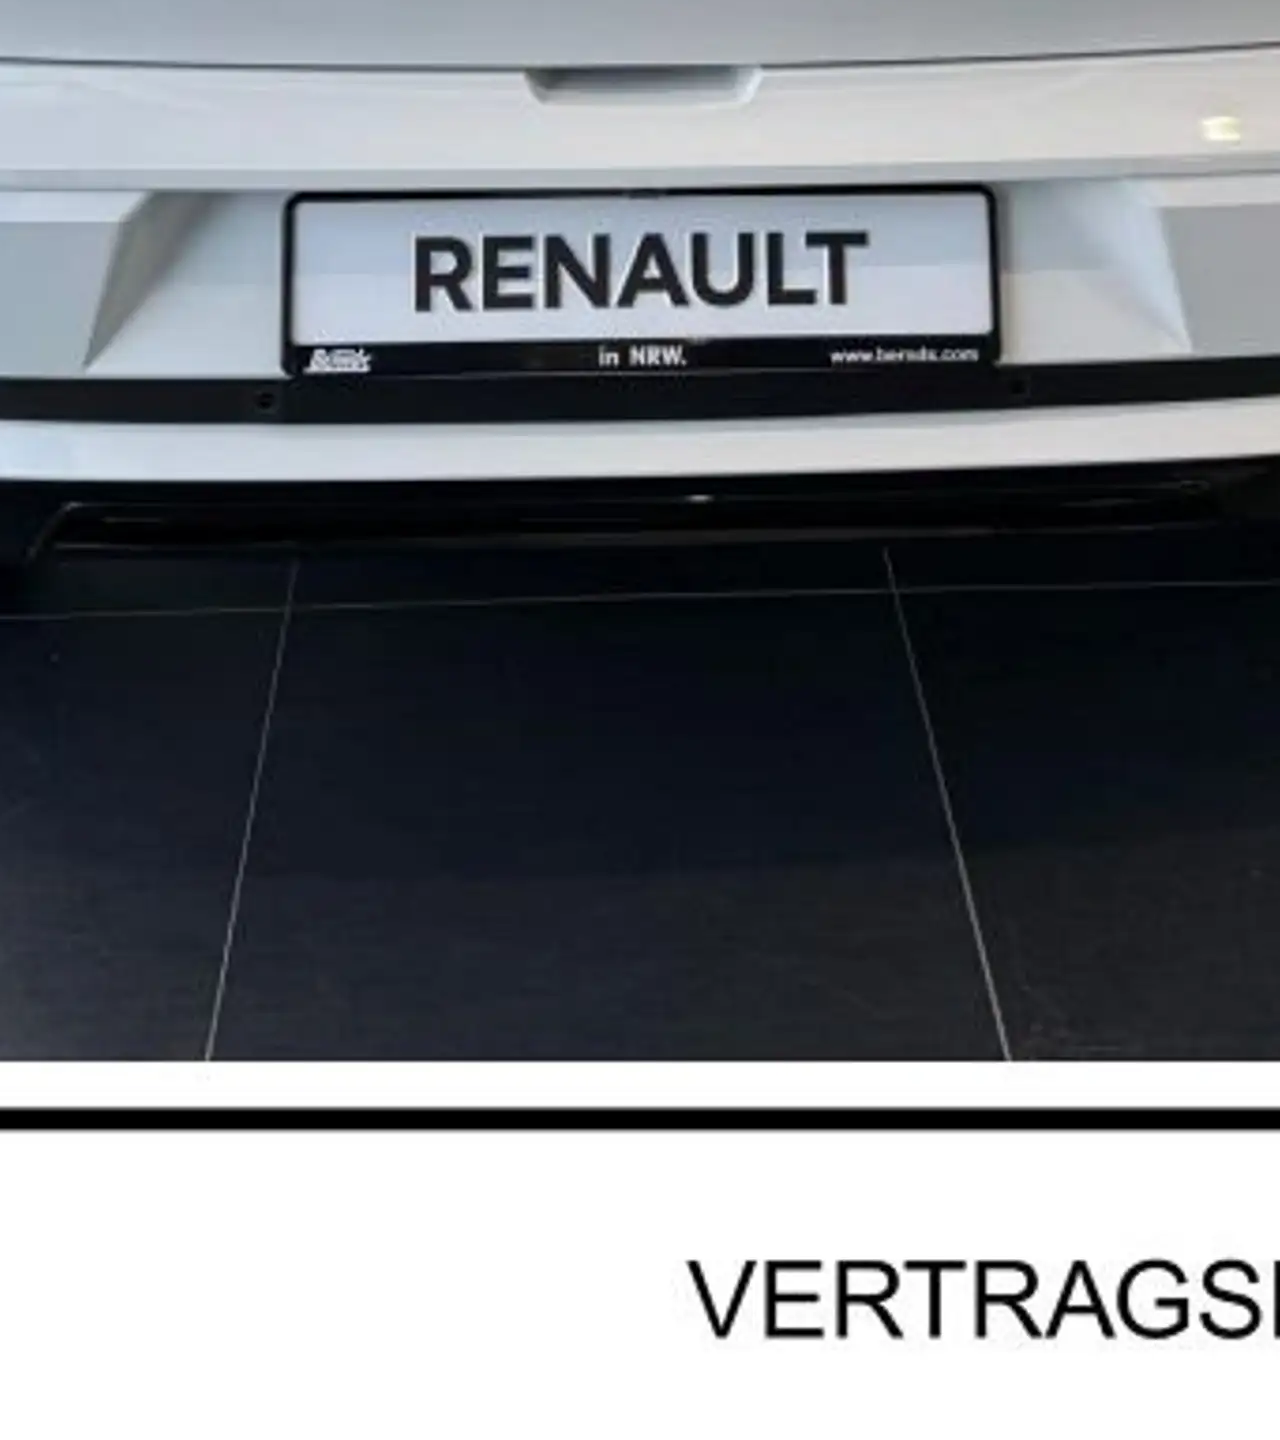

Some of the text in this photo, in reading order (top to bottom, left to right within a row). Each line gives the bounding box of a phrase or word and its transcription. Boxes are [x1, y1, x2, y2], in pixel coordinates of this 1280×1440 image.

[414, 230, 871, 313] RENAULT
[598, 344, 688, 367] in NRW.
[829, 346, 980, 364] www.bernds.com
